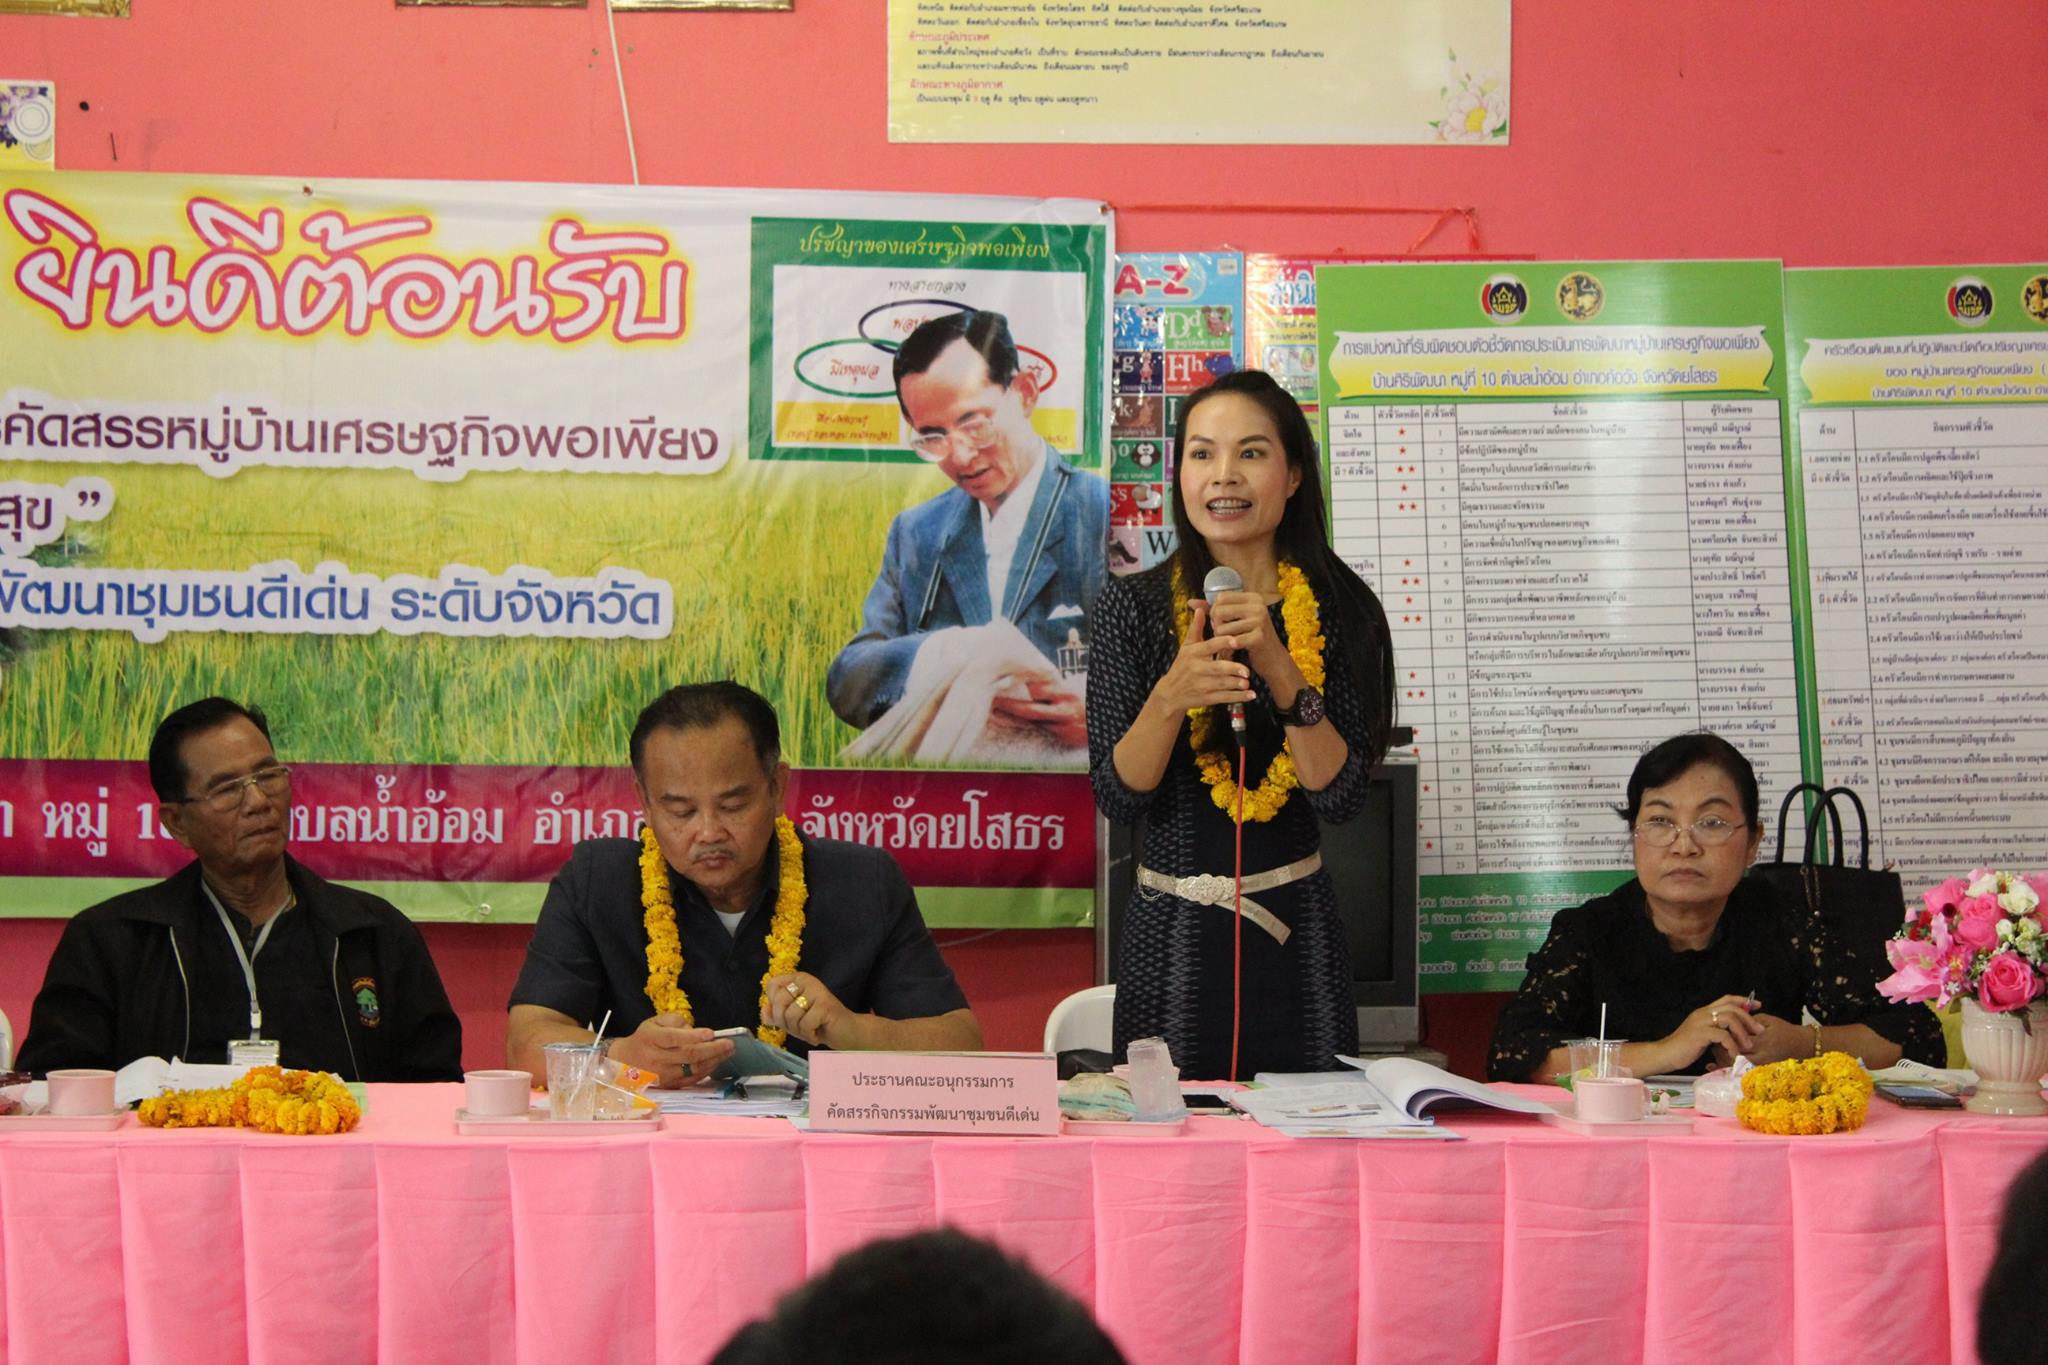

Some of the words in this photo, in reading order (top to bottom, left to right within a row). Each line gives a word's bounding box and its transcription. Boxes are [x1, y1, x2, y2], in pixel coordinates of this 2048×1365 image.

[799, 224, 1050, 264] ปรัชญาของเศรษฐกิจพอเพียง
[6, 189, 686, 342] ยินดีต้อนรับ
[1114, 264, 1189, 296] A-Z
[1451, 368, 1476, 391] หมู่ที่
[1482, 373, 1495, 385] 10
[393, 578, 660, 626] ระดับจังหวัด
[42, 786, 108, 857] หมู่
[137, 803, 172, 839] 1
[290, 775, 504, 844] บลน้ำอ้อม
[801, 789, 1064, 850] จังหวัดยโสธร
[852, 1072, 1014, 1091] ประธานคณะอนุกรรมการ
[827, 1104, 1039, 1126] คัดสรรกิจกรรมพัฒนาชุมชนดีเด่น
